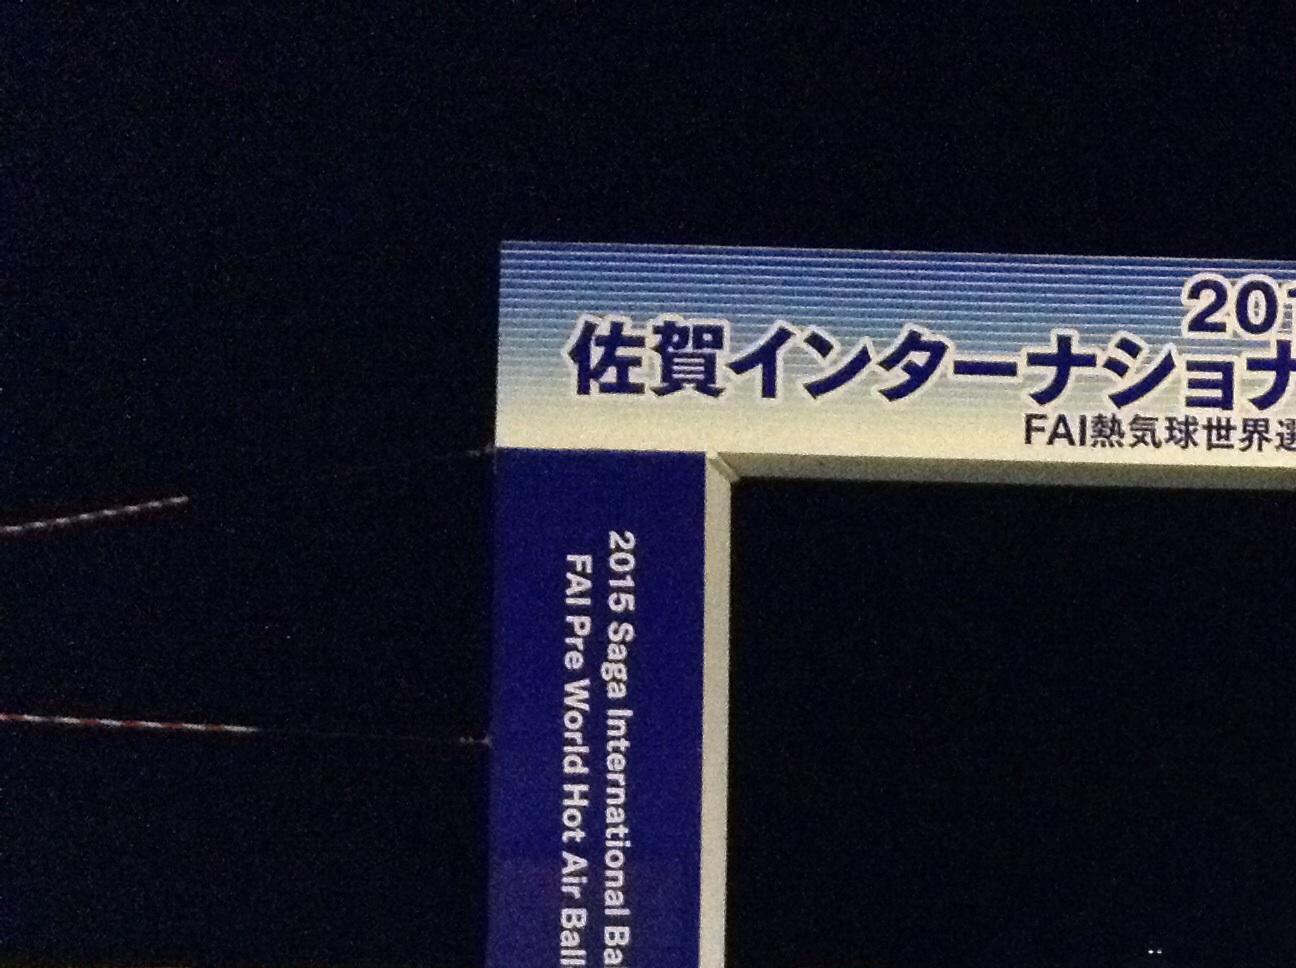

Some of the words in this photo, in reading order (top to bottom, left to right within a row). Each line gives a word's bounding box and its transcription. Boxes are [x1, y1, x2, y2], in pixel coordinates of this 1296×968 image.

[565, 554, 592, 605] FAI
[608, 531, 636, 613] 2015
[564, 615, 592, 670] Pre
[600, 621, 634, 699] Saga
[562, 679, 591, 775] World
[561, 784, 589, 843] Hot
[604, 709, 633, 915] International
[560, 851, 588, 899] Air
